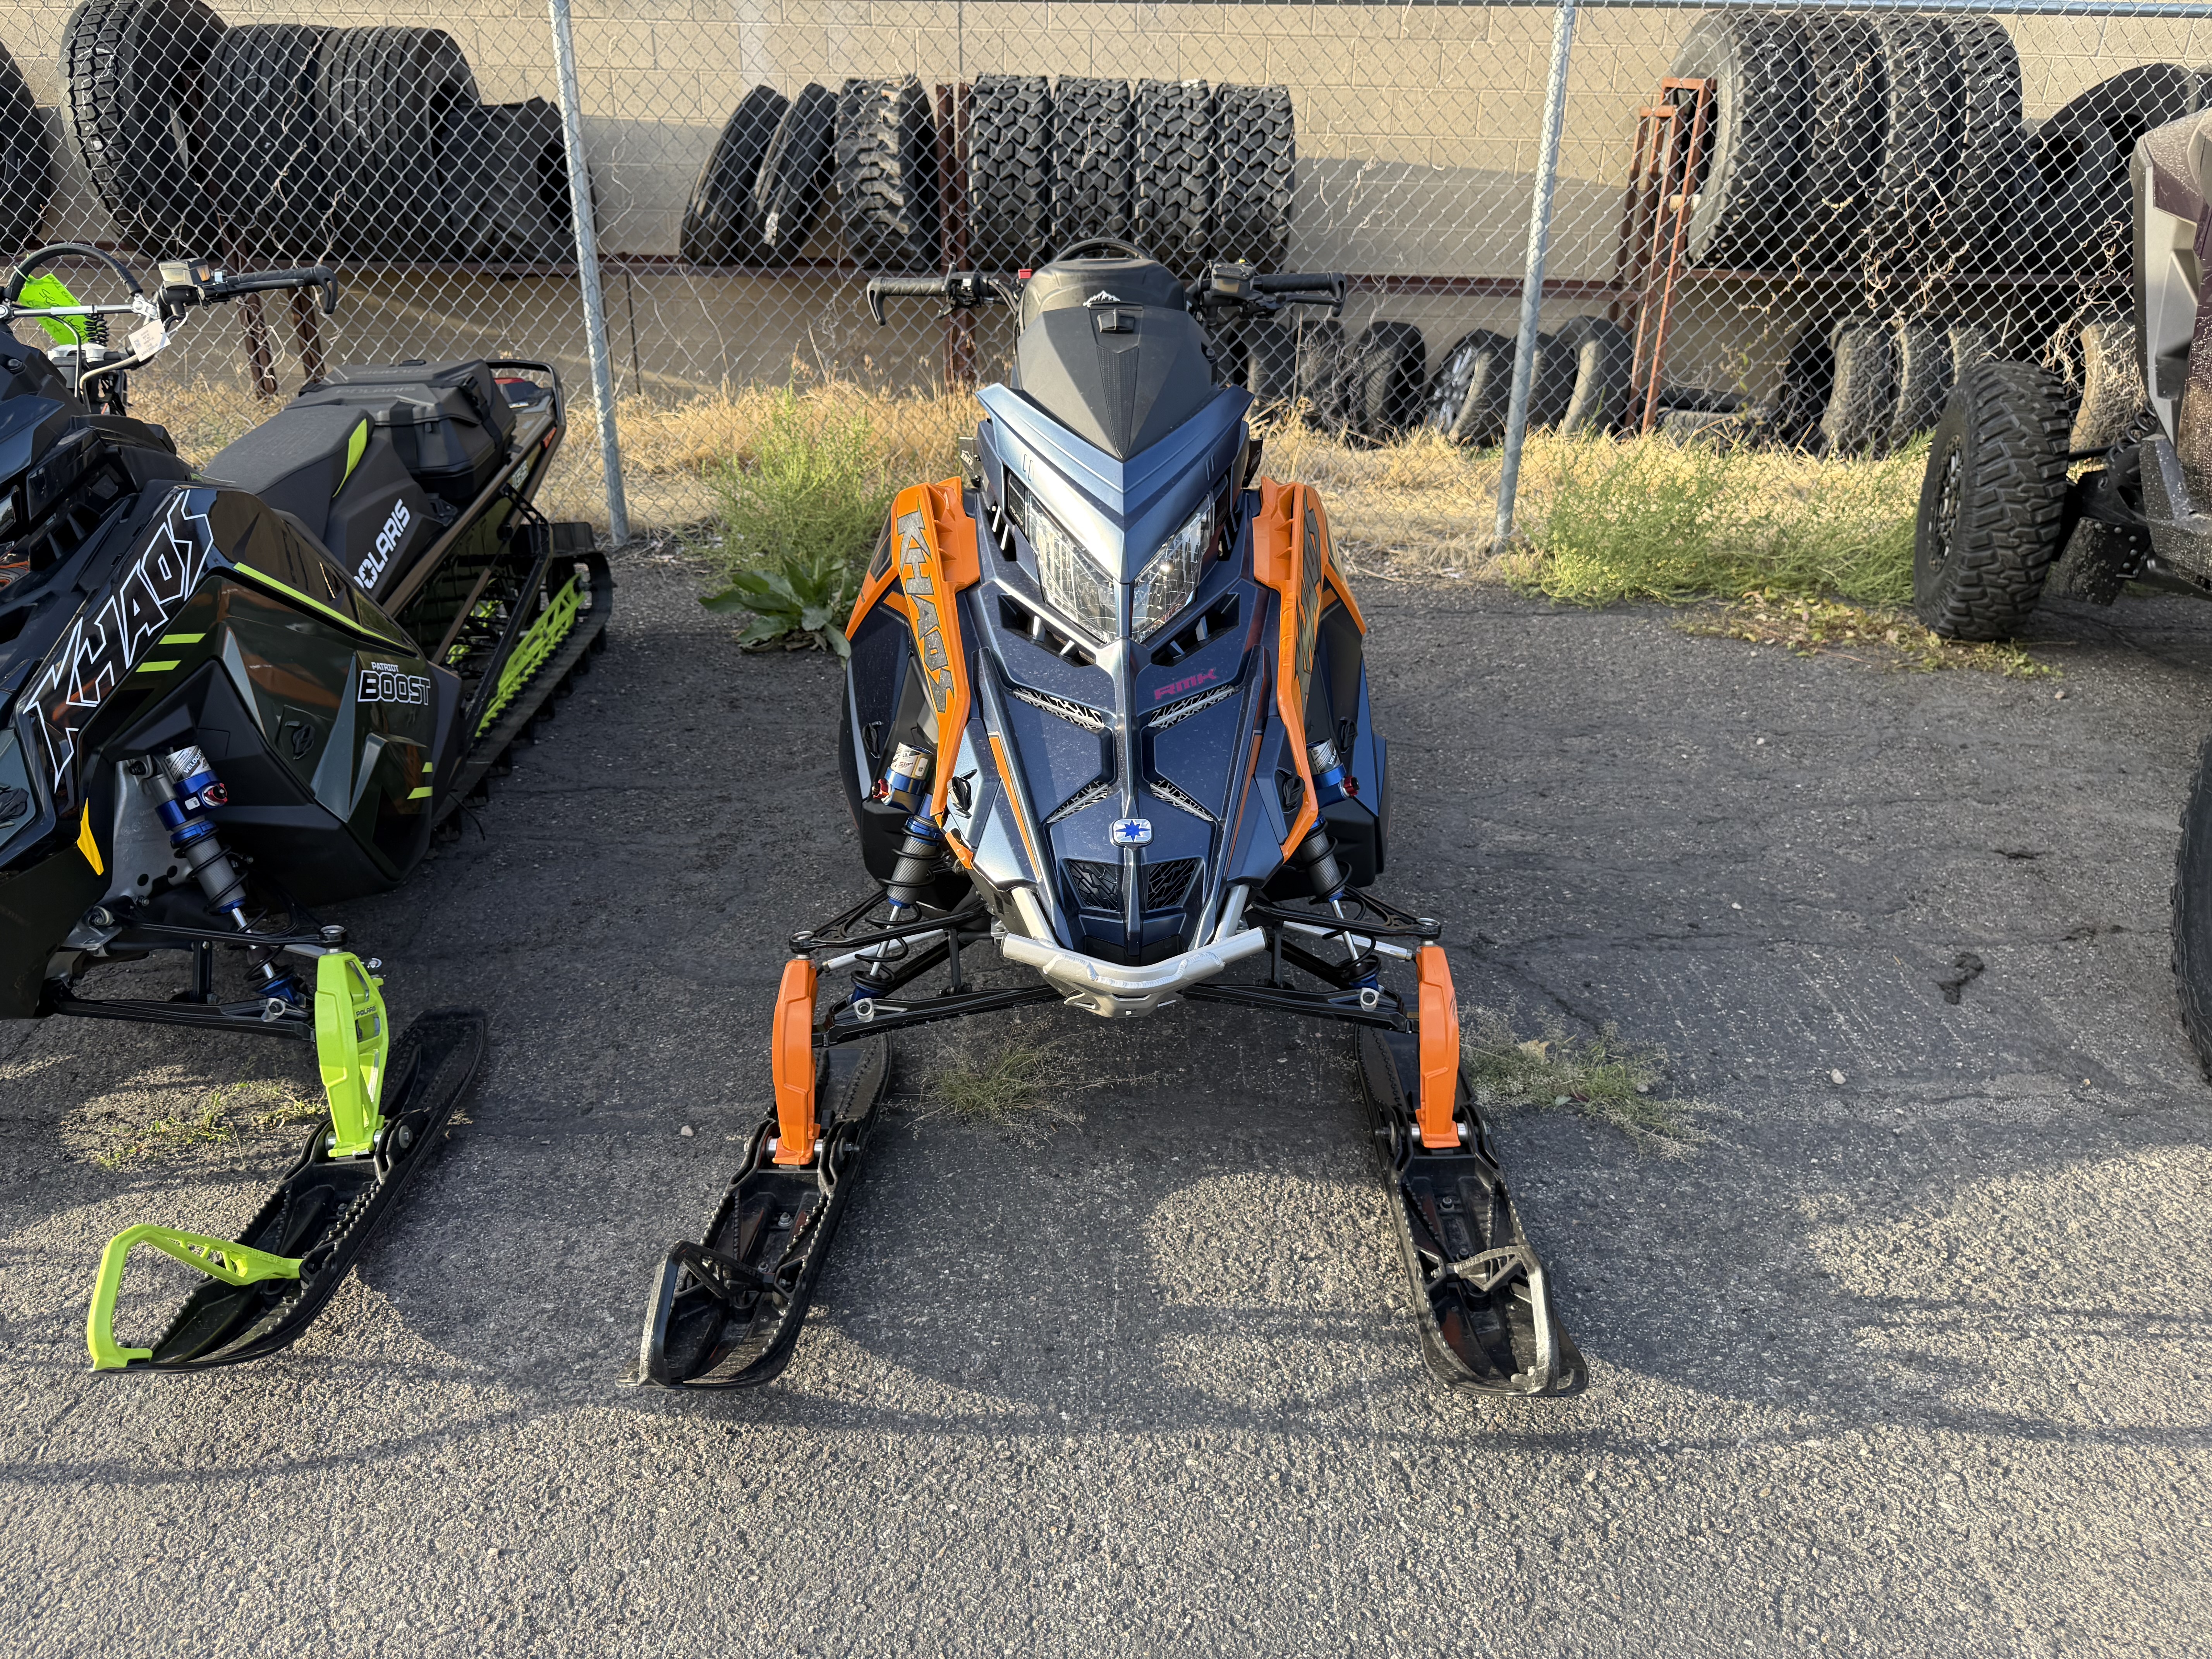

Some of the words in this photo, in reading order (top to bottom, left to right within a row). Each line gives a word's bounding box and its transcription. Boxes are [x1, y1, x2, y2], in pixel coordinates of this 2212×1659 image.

[896, 495, 955, 713] KHAOS
[23, 489, 214, 794] KHAOS
[371, 661, 399, 673] PATRIOT
[357, 670, 431, 706] BOOST
[1154, 668, 1217, 700] RMK
[356, 1005, 376, 1017] POLARIS
[247, 1249, 283, 1265] POLARIS
